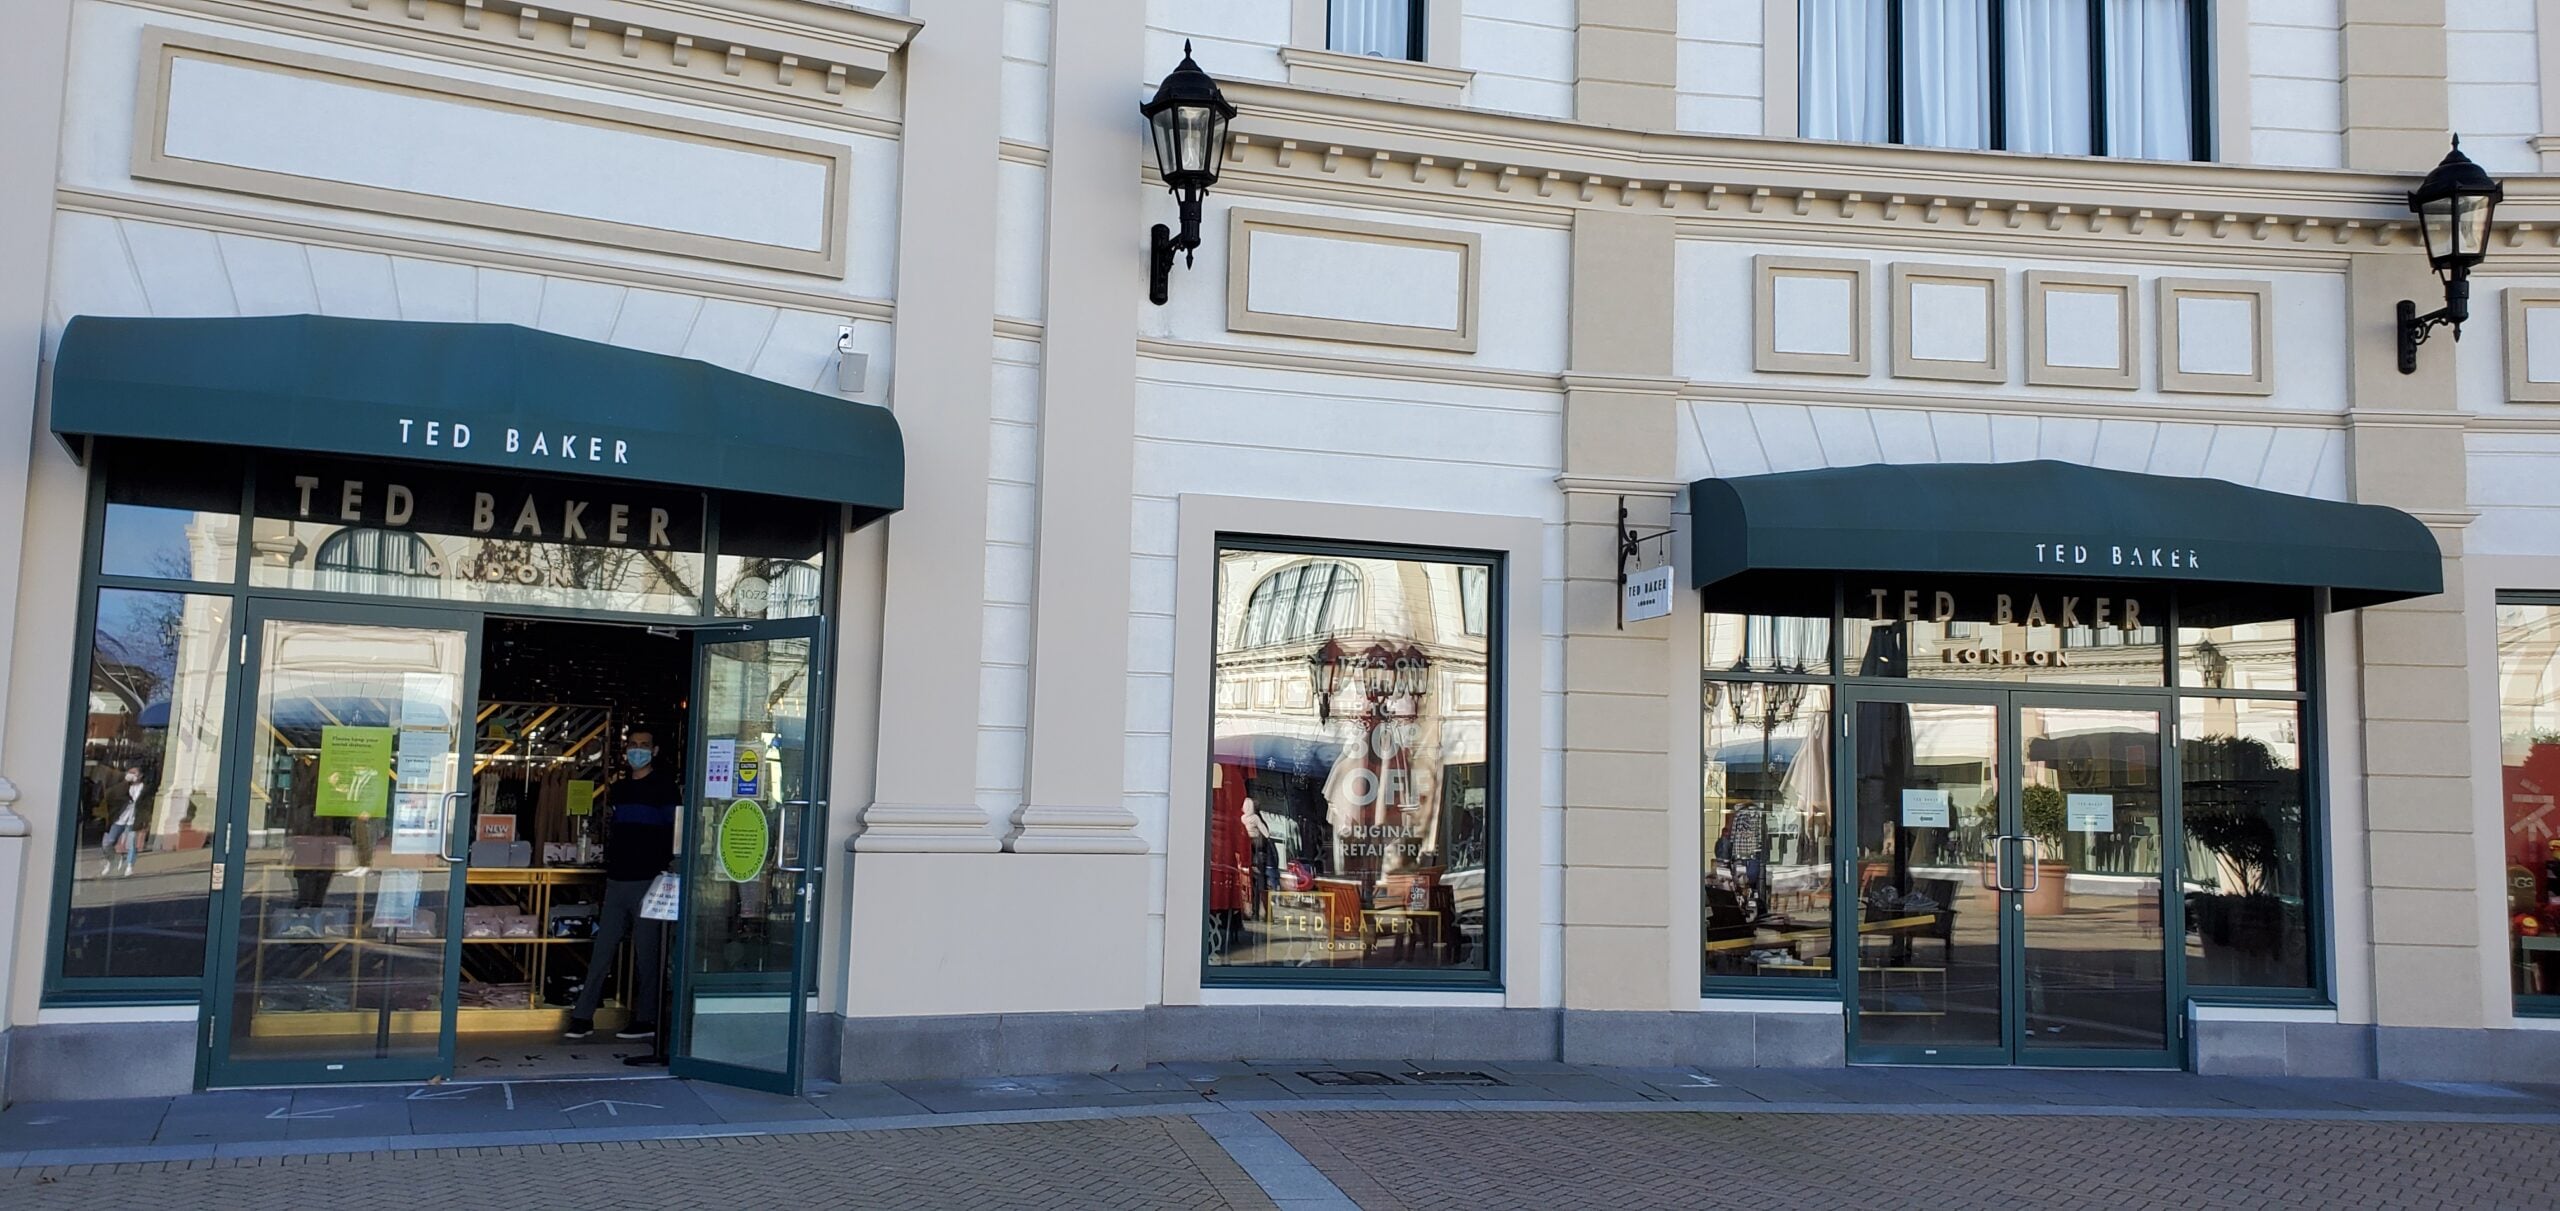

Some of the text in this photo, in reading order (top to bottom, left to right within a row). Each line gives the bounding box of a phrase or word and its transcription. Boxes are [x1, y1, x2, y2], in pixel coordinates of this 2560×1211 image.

[399, 418, 628, 464] TED BAKER
[294, 475, 671, 547] TED BAKER
[2035, 543, 2199, 569] TED BAKER
[403, 553, 574, 589] LONDON
[741, 589, 768, 601] 1072
[1628, 579, 1666, 597] TED BAKER
[1870, 588, 2142, 630] TED BAKER
[1395, 657, 1426, 671] ON
[1947, 649, 2069, 668] LONDON
[1342, 767, 1430, 807] OFF
[485, 824, 508, 833] NEW
[1341, 825, 1425, 839] ORIGINAL
[1284, 915, 1414, 934] TED BAKER
[1319, 941, 1379, 951] LONDON
